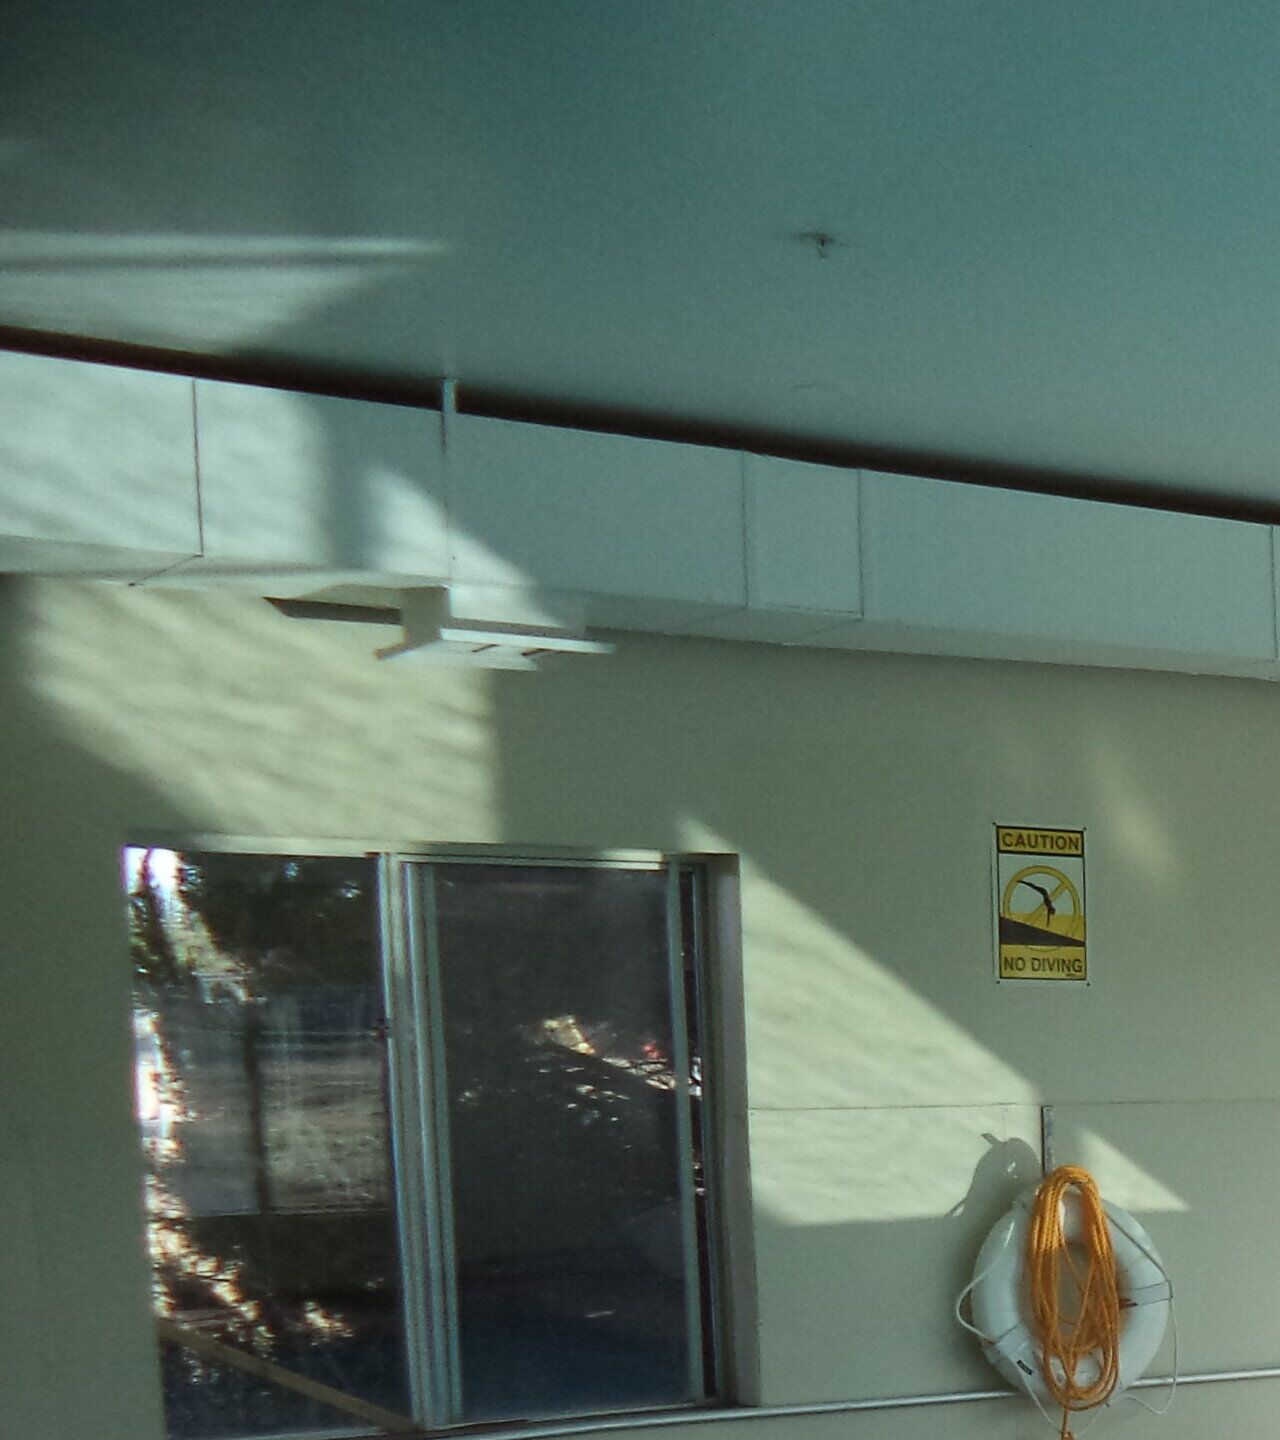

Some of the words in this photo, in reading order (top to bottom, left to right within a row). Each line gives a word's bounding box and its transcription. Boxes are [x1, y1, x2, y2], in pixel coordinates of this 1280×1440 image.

[1002, 832, 1079, 851] CAUTION
[1003, 957, 1026, 971] NO
[1031, 957, 1083, 974] DIVING
